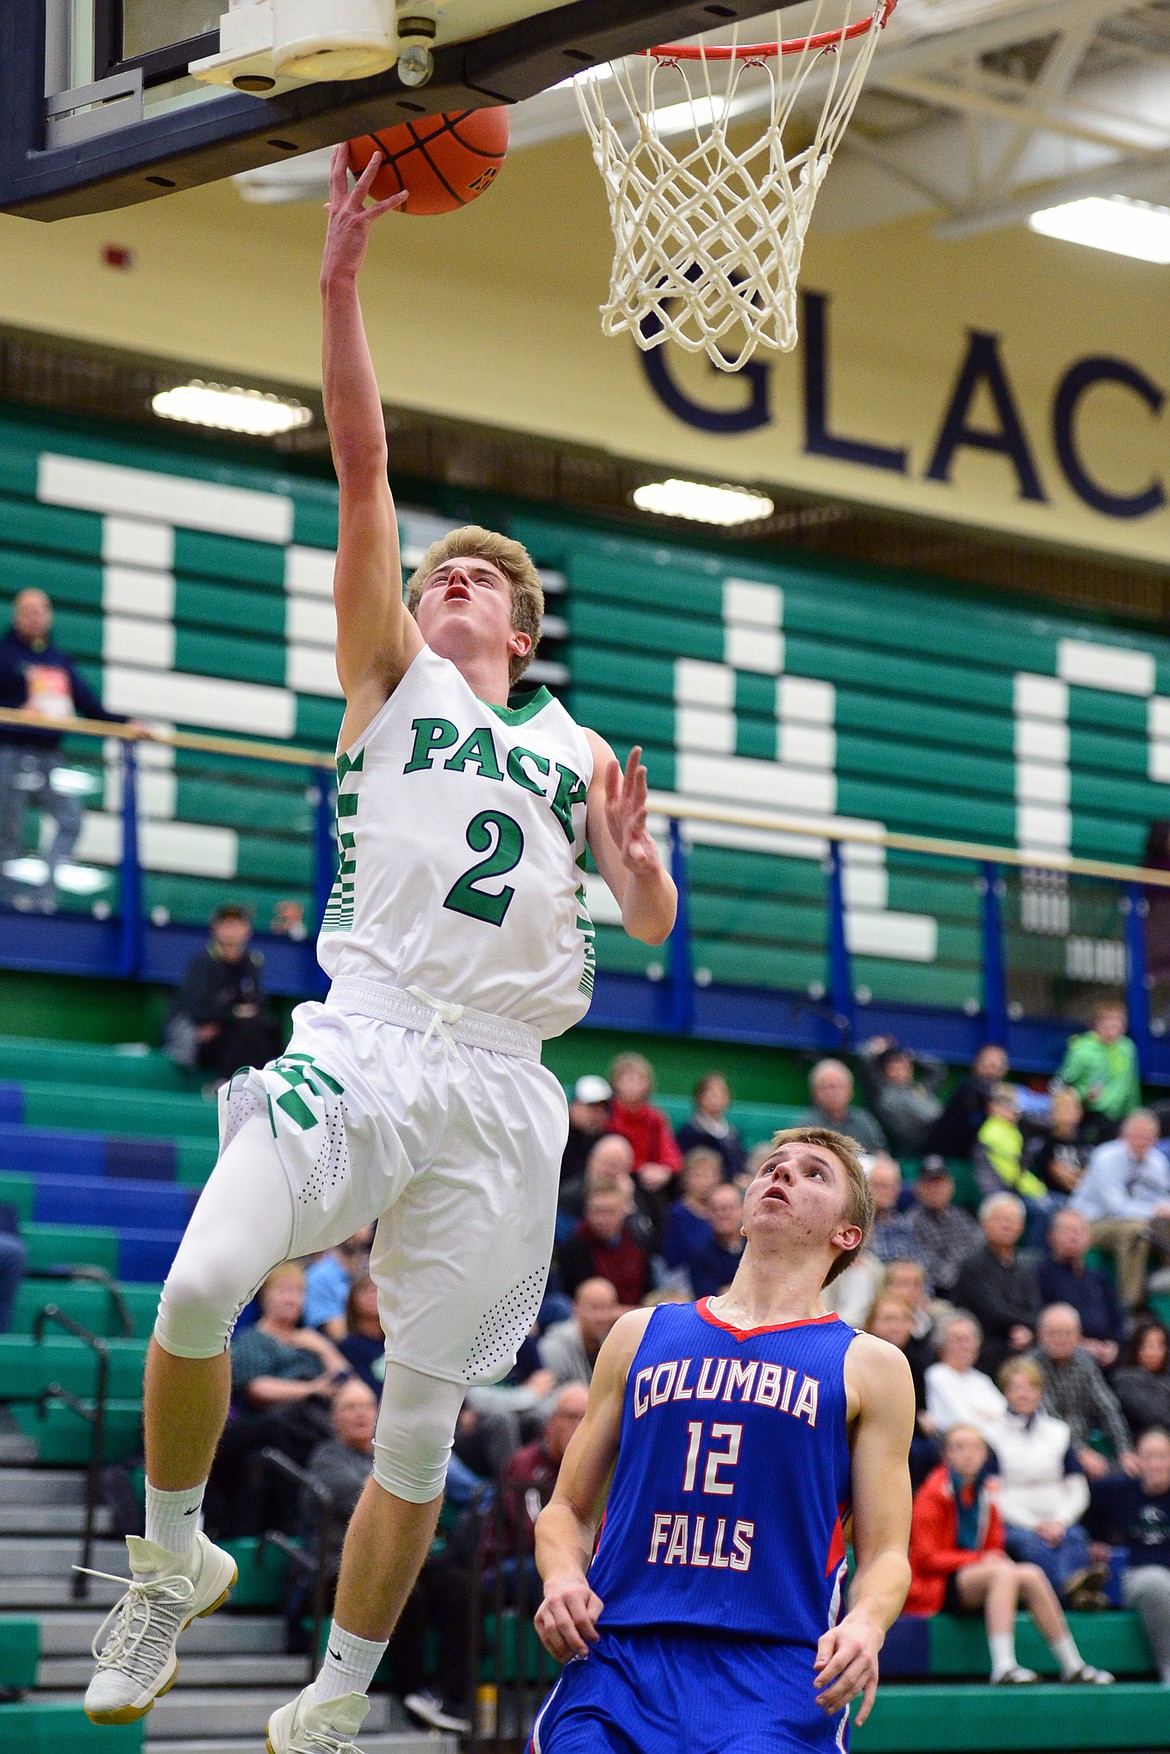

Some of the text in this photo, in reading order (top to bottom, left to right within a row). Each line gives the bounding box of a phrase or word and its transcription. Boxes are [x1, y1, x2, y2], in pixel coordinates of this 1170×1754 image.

[636, 257, 1166, 521] GLAC
[402, 716, 587, 845] PACK
[442, 808, 525, 928] 2
[634, 1356, 821, 1428] COLUMBIA
[682, 1419, 744, 1496] 12
[647, 1511, 755, 1573] FALLS
